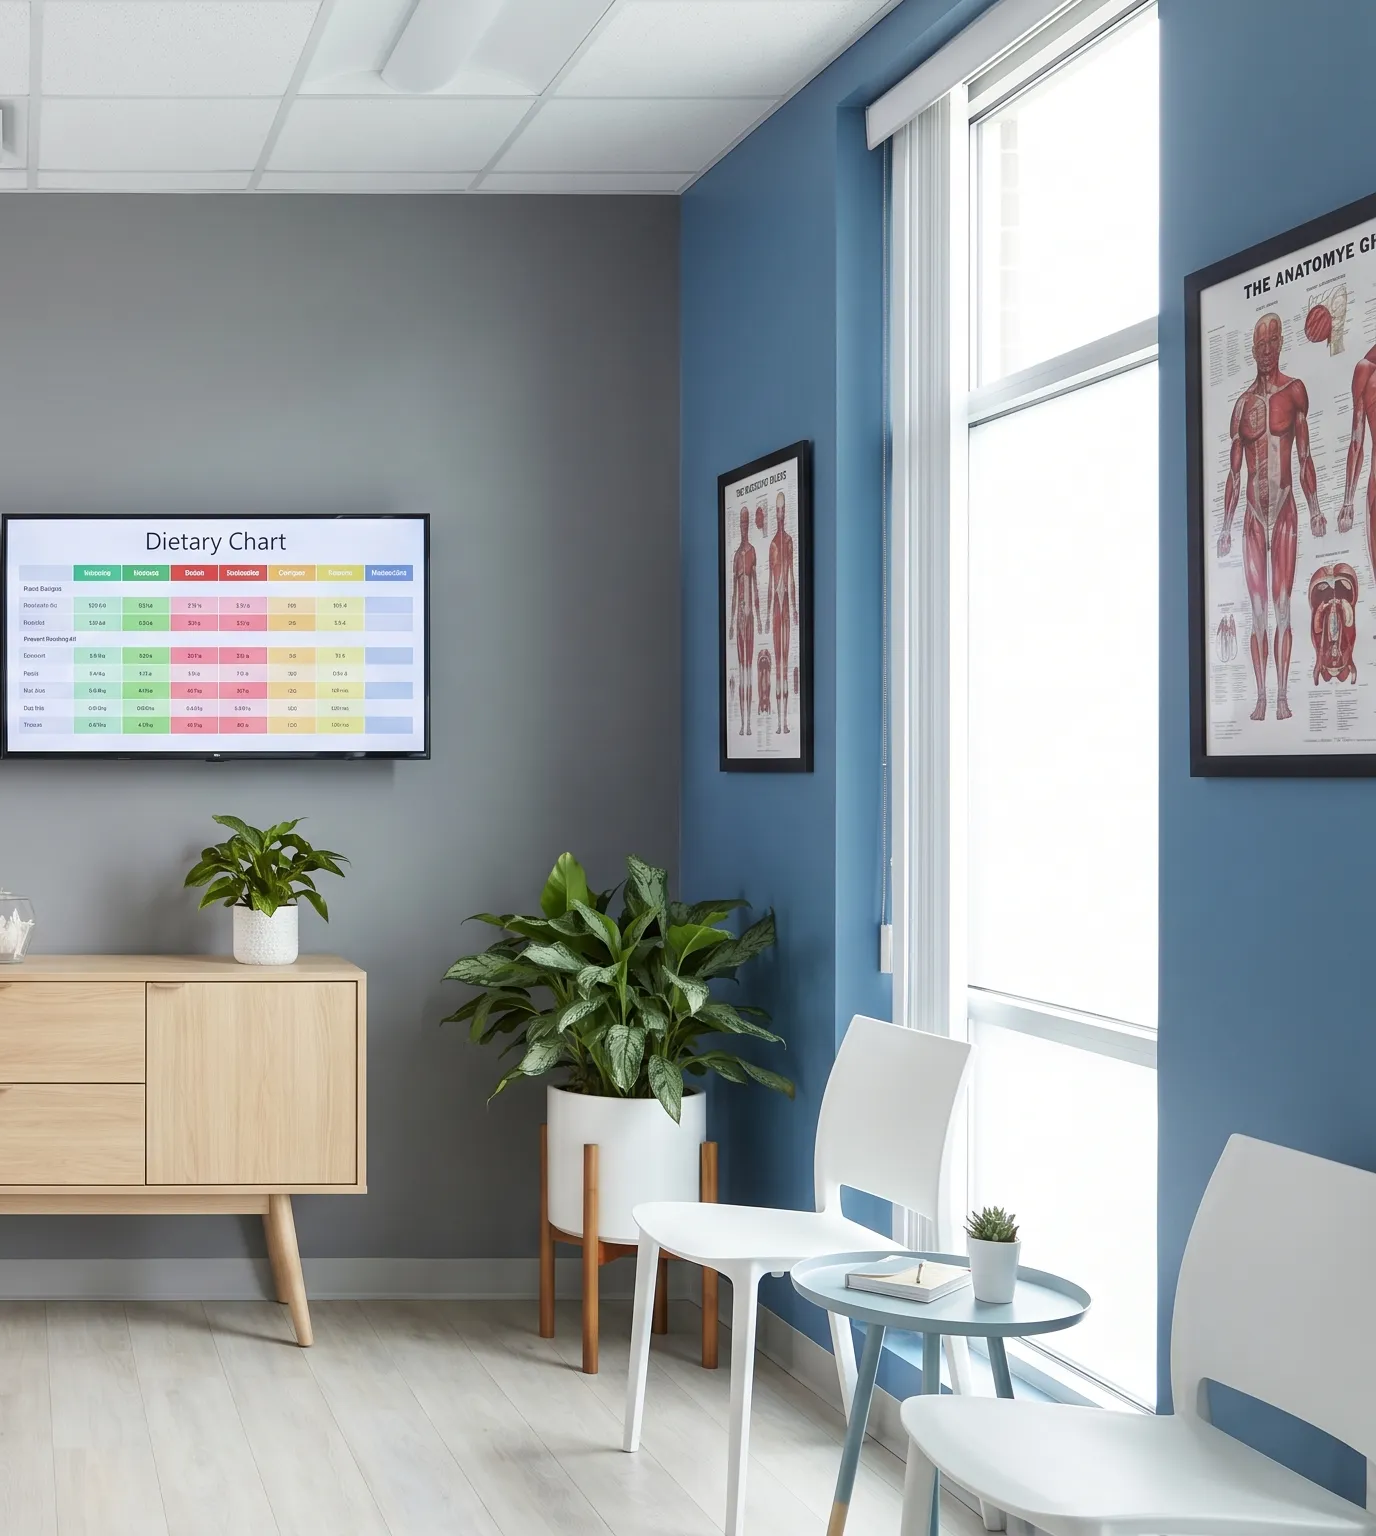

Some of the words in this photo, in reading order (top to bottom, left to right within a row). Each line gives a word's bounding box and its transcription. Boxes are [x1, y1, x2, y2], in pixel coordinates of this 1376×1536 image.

[1244, 276, 1271, 299] THE
[1275, 242, 1355, 287] ANATOMYE
[146, 531, 222, 556] Dietary
[229, 531, 287, 551] Chart
